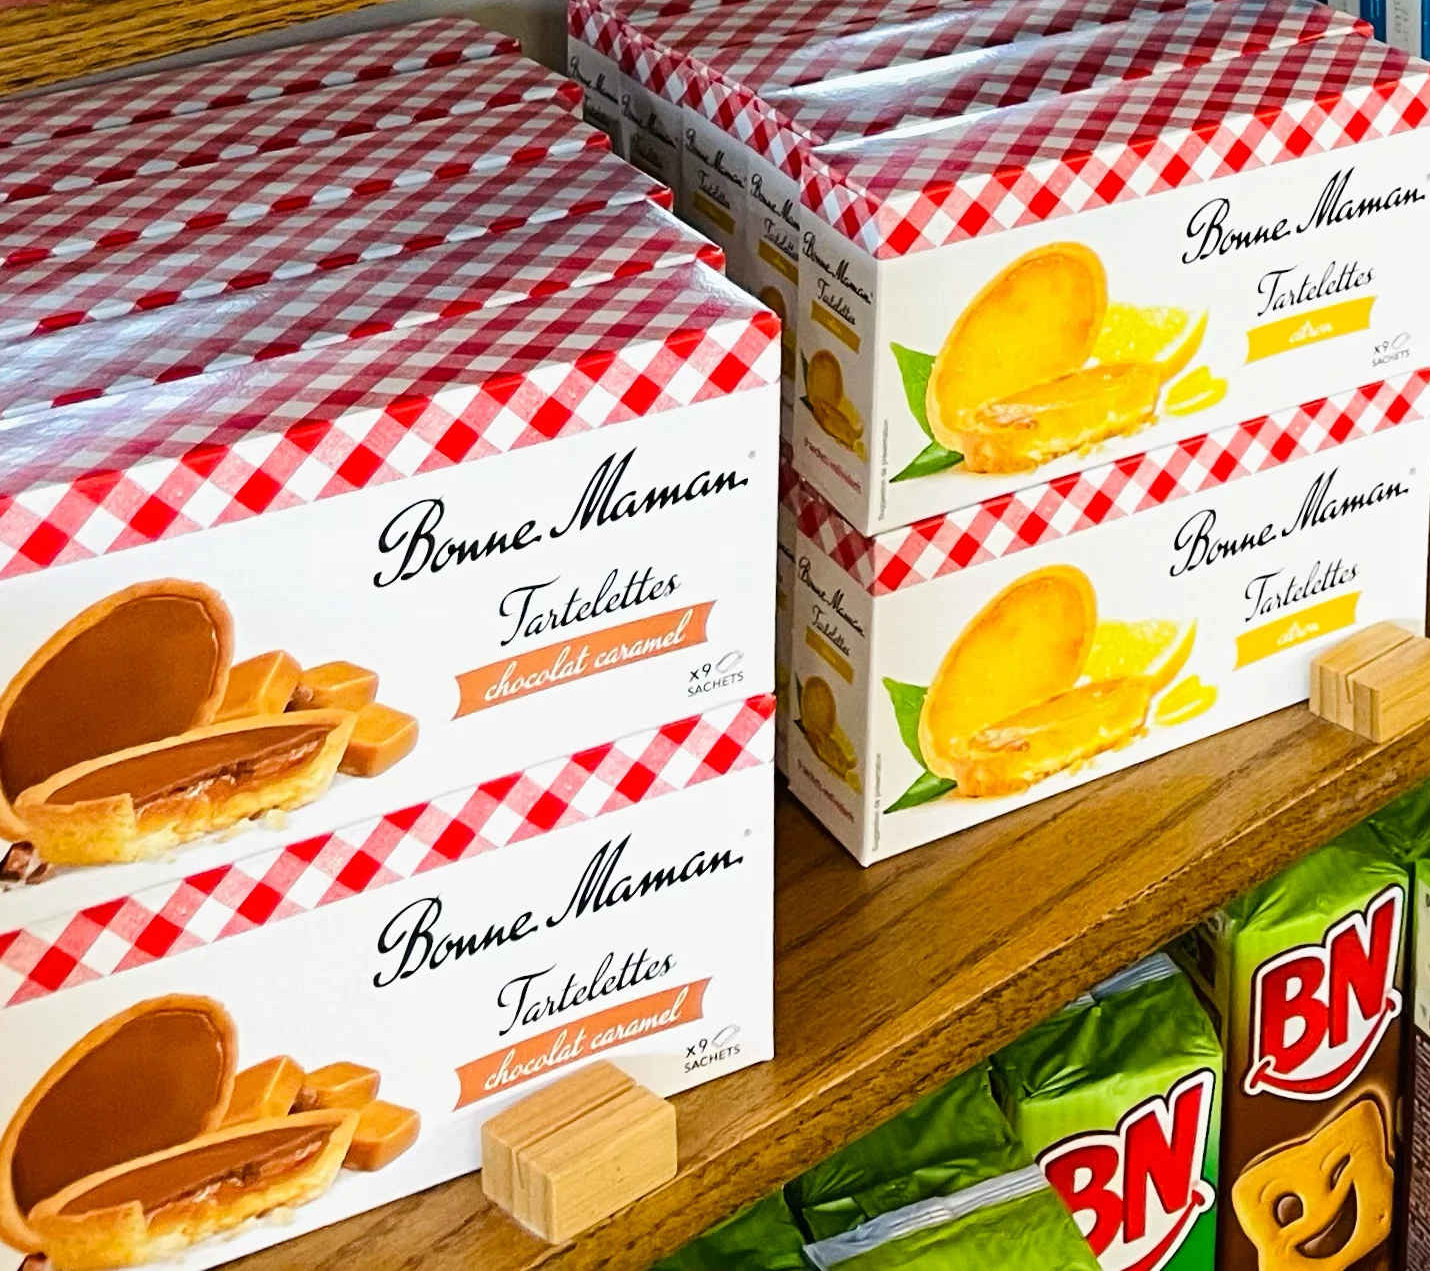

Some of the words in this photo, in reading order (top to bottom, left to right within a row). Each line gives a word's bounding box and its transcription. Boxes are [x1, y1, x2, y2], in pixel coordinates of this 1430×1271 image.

[1182, 196, 1292, 265] Bonne
[1296, 165, 1427, 234] Maman
[1256, 259, 1376, 318] Tartelettes
[374, 494, 544, 589] Bonne
[550, 445, 750, 540] Maman
[1168, 508, 1276, 577] Bonne
[1281, 467, 1410, 539] Maman
[497, 567, 683, 648] Tartelettes
[1243, 558, 1360, 624] Tartelettes
[484, 646, 592, 703] chocolat
[597, 623, 689, 676] caramel
[686, 669, 745, 698] SACHETS
[373, 892, 541, 989] Bonne
[546, 831, 745, 928] Maman
[497, 945, 678, 1036] Tartelettes
[1260, 901, 1396, 1074] BN
[483, 1027, 589, 1091] chocolat
[591, 1000, 685, 1054] caramel
